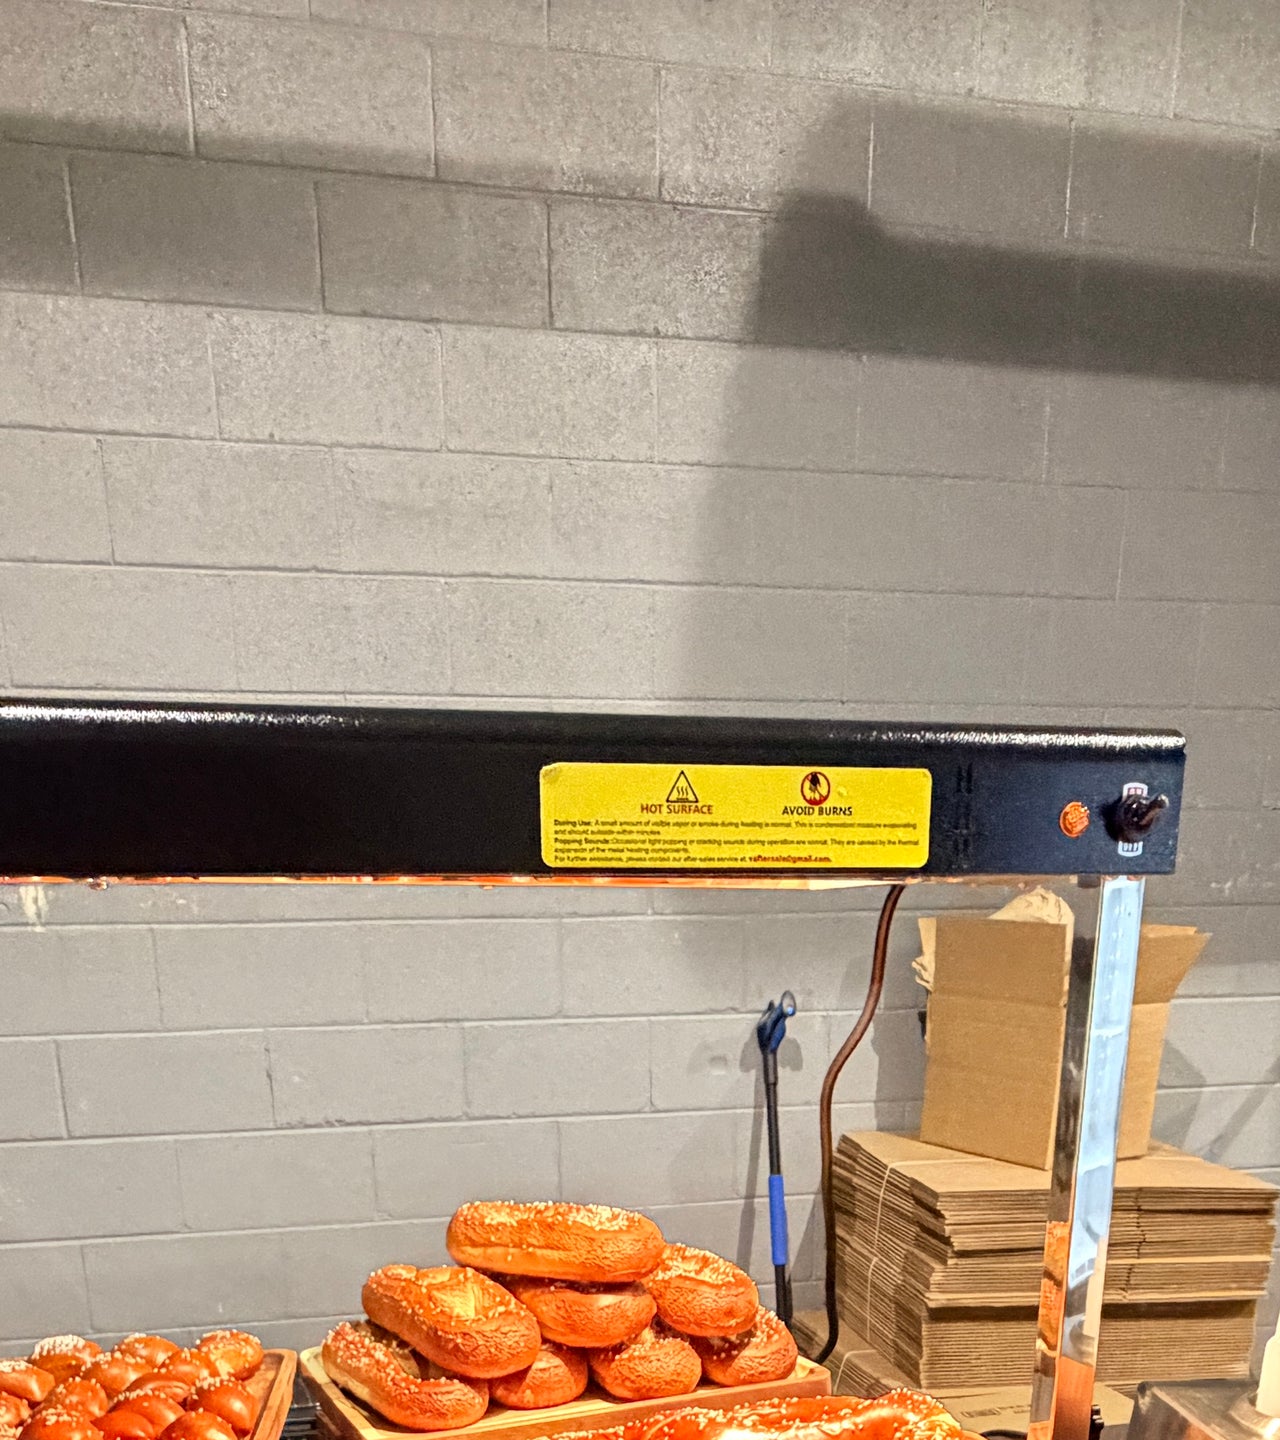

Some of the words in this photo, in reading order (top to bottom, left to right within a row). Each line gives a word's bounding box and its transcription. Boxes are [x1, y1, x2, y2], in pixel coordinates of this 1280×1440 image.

[640, 803, 663, 814] HOT
[666, 804, 713, 815] SURFACE
[781, 805, 814, 816] AVOID
[818, 806, 853, 816] BURNS
